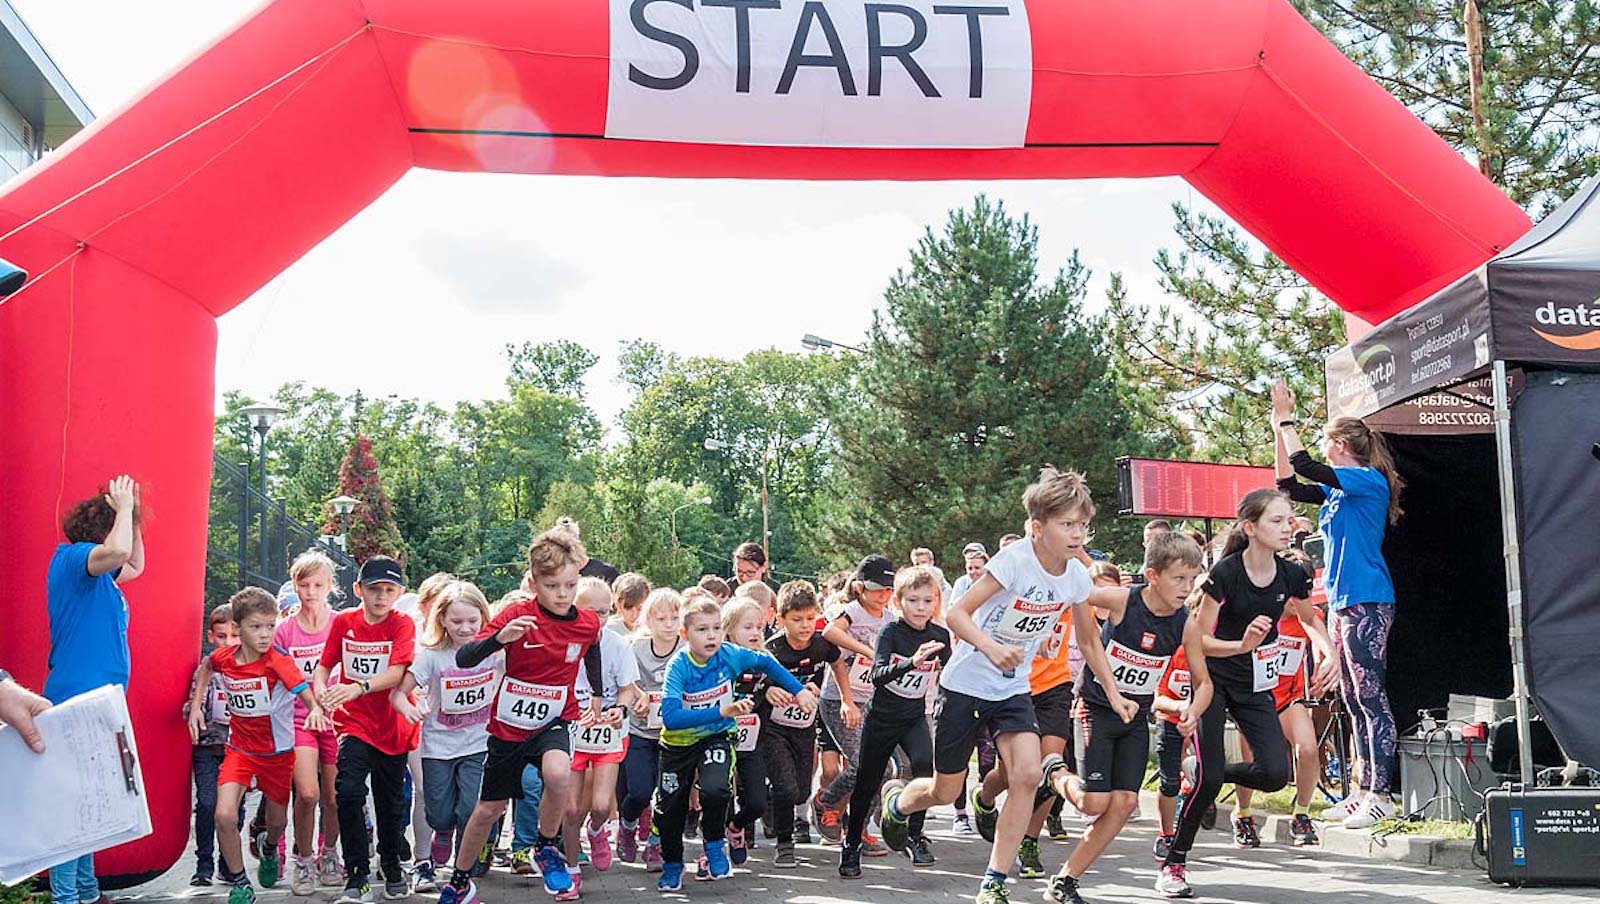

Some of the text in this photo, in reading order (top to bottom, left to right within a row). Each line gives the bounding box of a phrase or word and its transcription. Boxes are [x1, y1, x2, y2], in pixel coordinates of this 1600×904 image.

[628, 0, 1009, 98] START
[1021, 602, 1060, 612] DATASPORT
[1014, 616, 1049, 633] 455
[352, 658, 379, 674] 457
[1117, 649, 1161, 667] DATASPORT
[450, 674, 492, 687] DATASPORT
[1113, 665, 1150, 686] 469
[454, 688, 486, 706] 464
[511, 684, 557, 698] DATASPORT
[511, 699, 550, 720] 449
[581, 727, 611, 745] 479
[703, 749, 726, 765] 10
